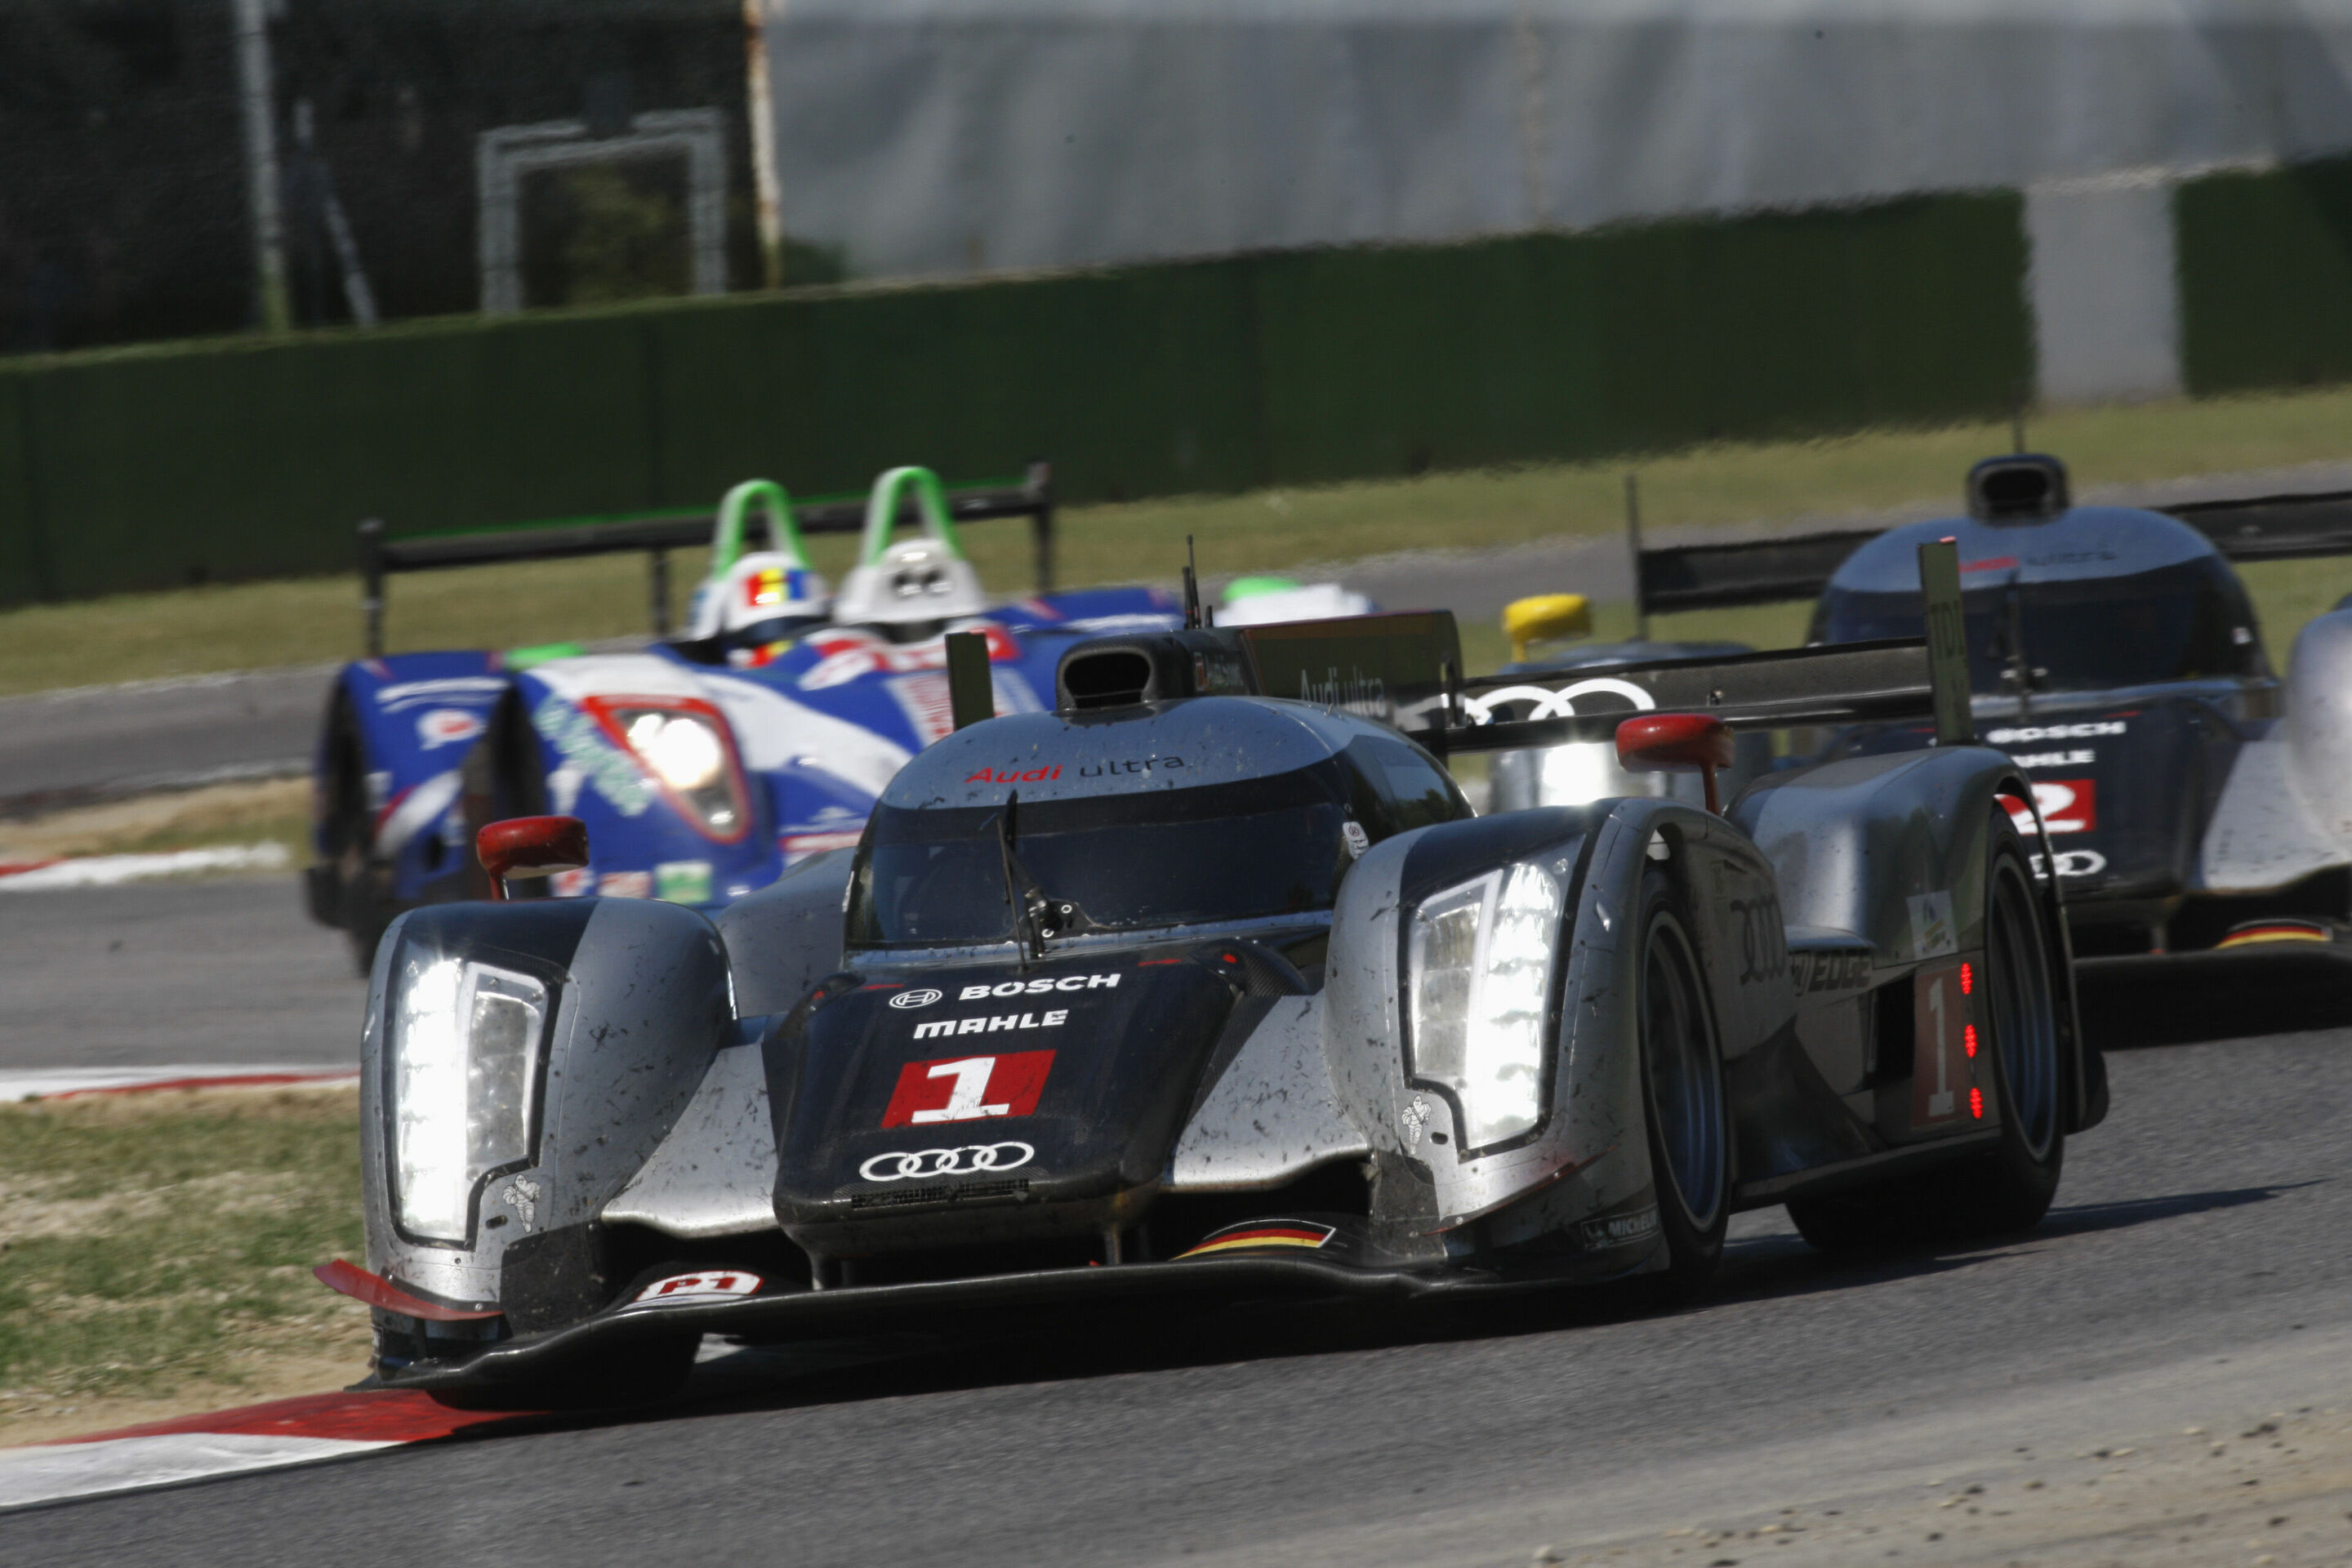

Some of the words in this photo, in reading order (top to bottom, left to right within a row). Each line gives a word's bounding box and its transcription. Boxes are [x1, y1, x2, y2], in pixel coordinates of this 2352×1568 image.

[1300, 666, 1340, 705] Audi
[1343, 665, 1387, 716] ultra
[964, 764, 1064, 784] Audi
[1079, 755, 1184, 777] ultra
[1993, 783, 2087, 835] 2
[958, 973, 1121, 1000] BOSCH
[913, 1009, 1070, 1039] MAHLE
[1928, 977, 1955, 1117] 1
[911, 1057, 1010, 1124] 1
[657, 1276, 738, 1295] P1
